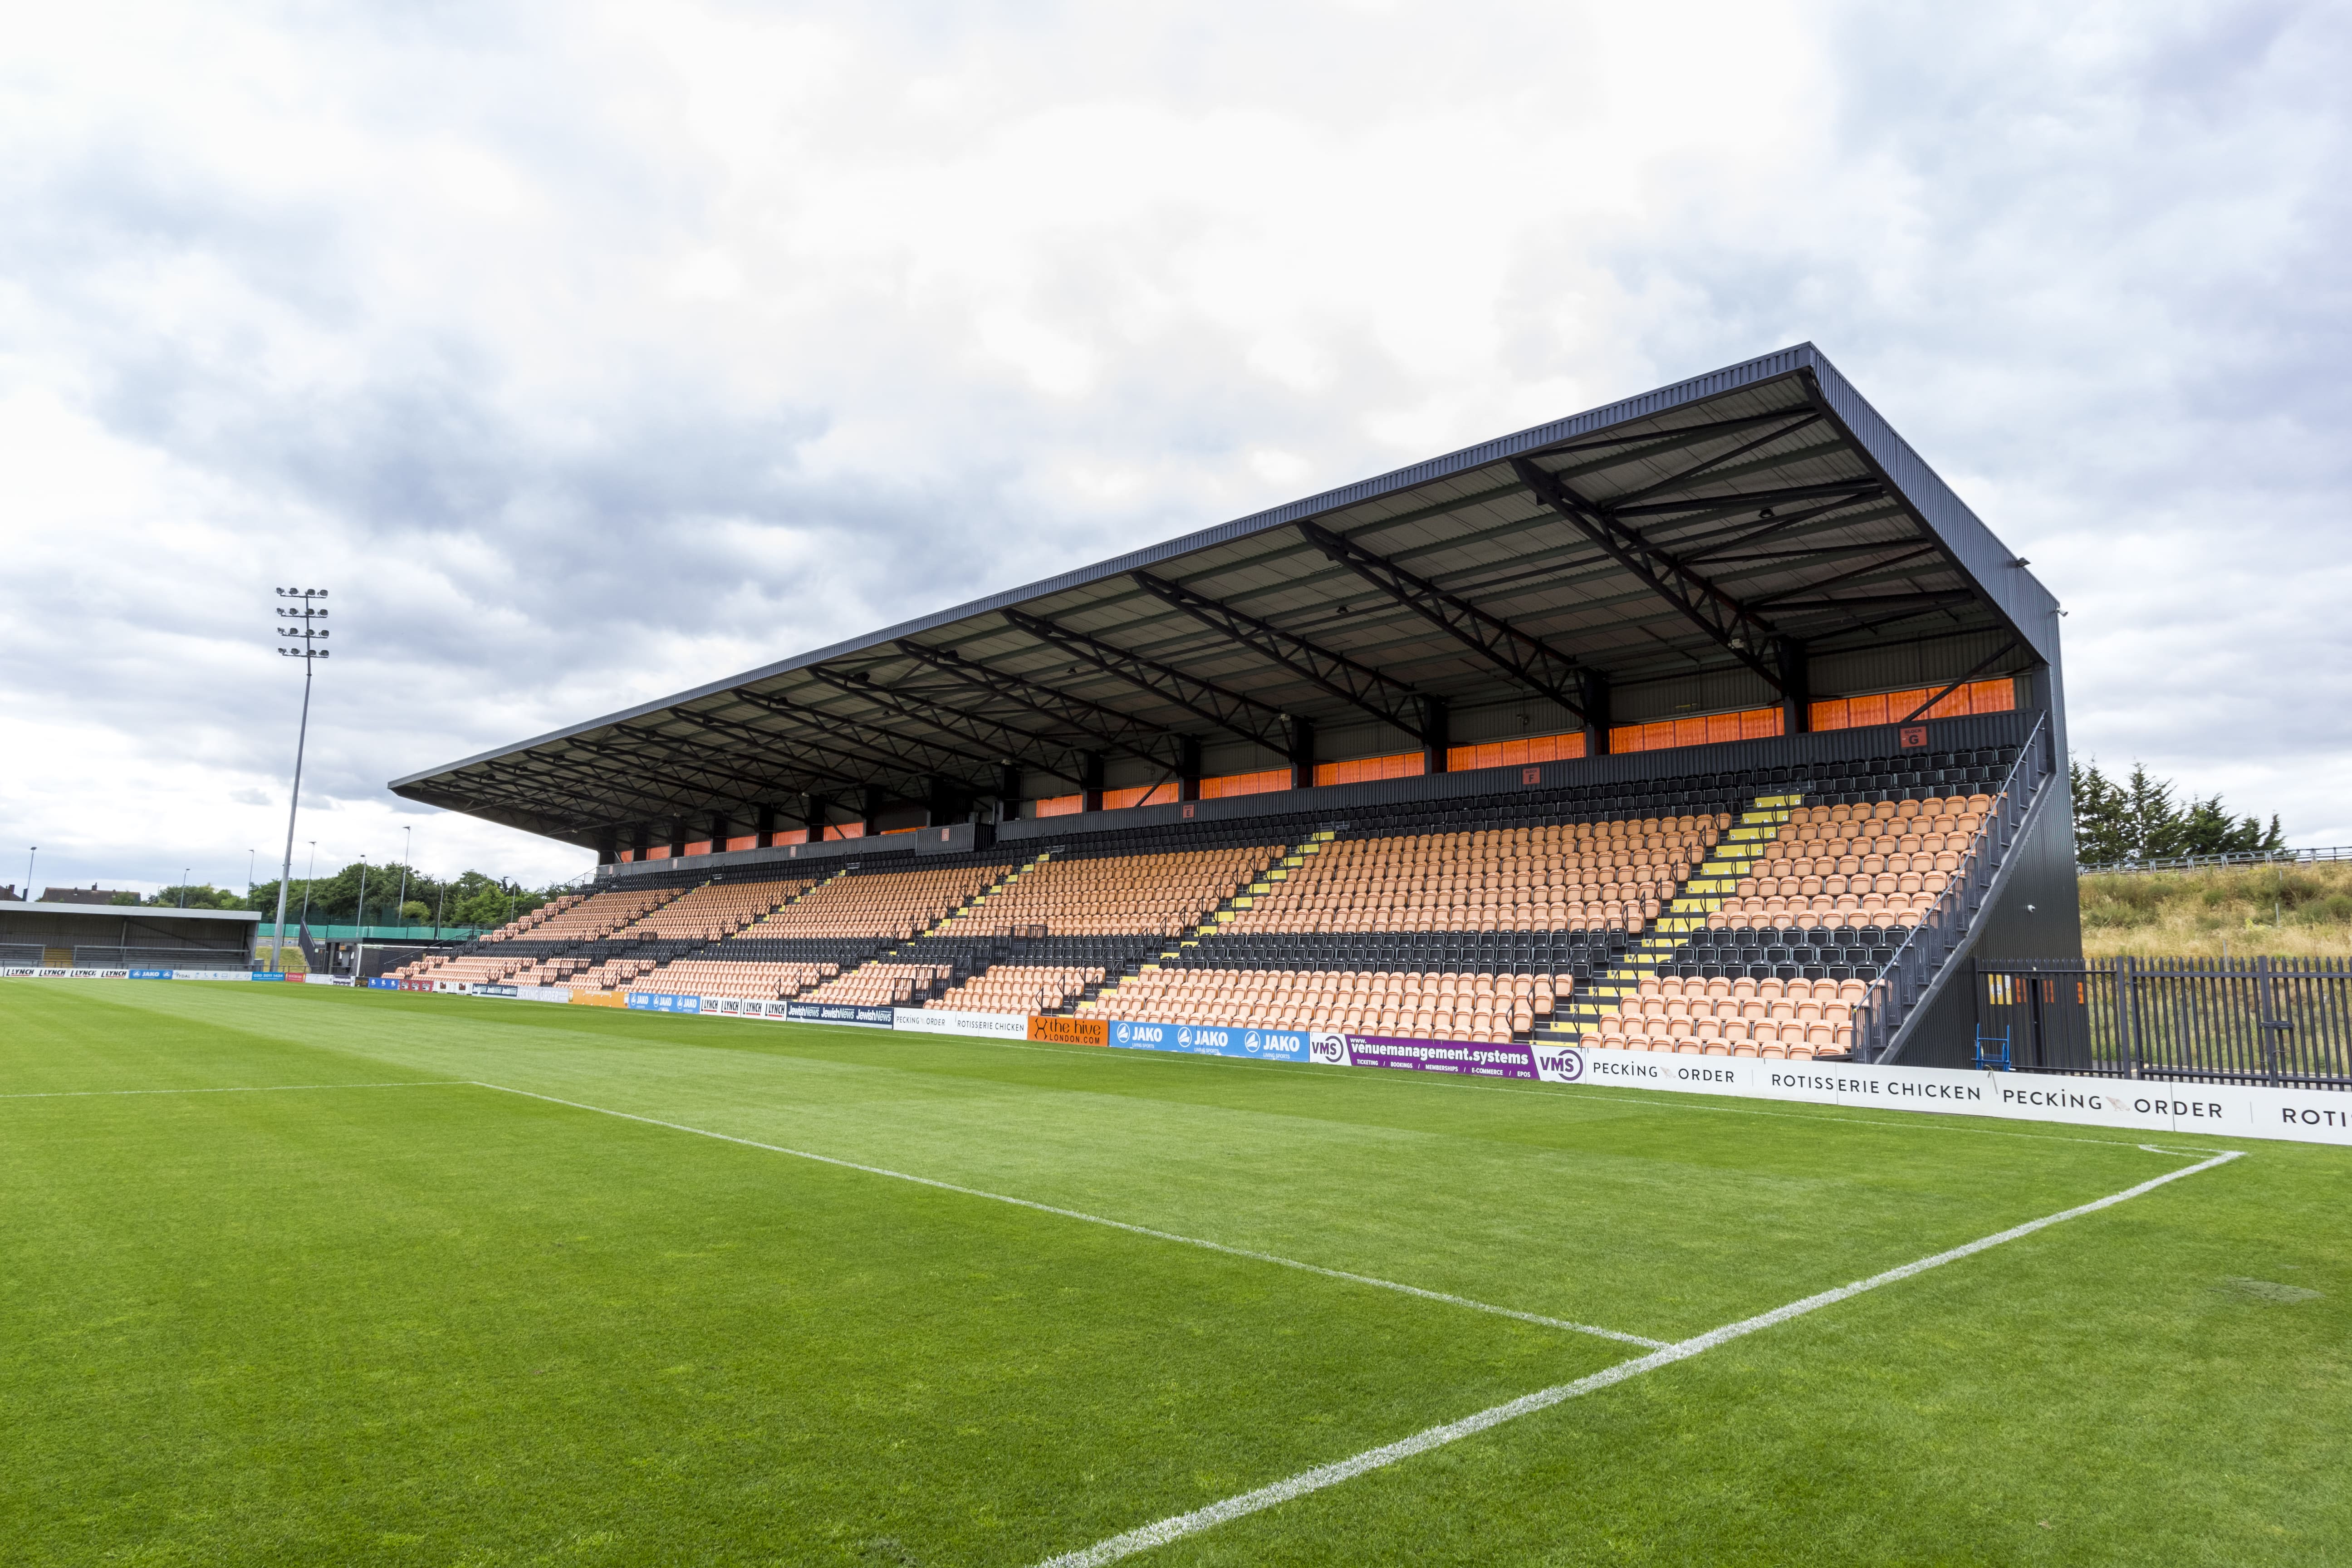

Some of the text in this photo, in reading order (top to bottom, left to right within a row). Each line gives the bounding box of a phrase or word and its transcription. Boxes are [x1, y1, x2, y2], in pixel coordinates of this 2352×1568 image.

[1909, 735, 1919, 745] G
[1529, 774, 1534, 783] F
[540, 990, 559, 1001] ORDER
[637, 995, 649, 1004] JAKO
[659, 996, 672, 1006] JAKO
[683, 998, 697, 1009] JAKO
[704, 1000, 718, 1009] LYNCH
[724, 1001, 739, 1011] LYNCH
[746, 1002, 762, 1013] LYNCH
[769, 1004, 785, 1014] LYNCH
[926, 1018, 945, 1026] ORDER
[957, 1020, 993, 1029] ROTISSERIE
[995, 1023, 1024, 1031] CHICKEN
[1050, 1019, 1101, 1035] the hive
[1049, 1034, 1100, 1044] LONDON.COM
[1132, 1027, 1162, 1042] JAKO
[1194, 1030, 1228, 1047] JAKO
[1263, 1035, 1300, 1052] JAKO
[1312, 1041, 1337, 1055] VMS
[1351, 1043, 1529, 1065] venuemanagement.systems
[1425, 1063, 1459, 1072] MEMBERSHIPS
[1471, 1067, 1503, 1076] E-COMMERCE
[1540, 1056, 1574, 1073] VMS
[1678, 1068, 1734, 1083] ORDER
[1772, 1074, 1879, 1094] ROTISSERIE
[1887, 1082, 1980, 1100] CHICKEN
[2134, 1098, 2222, 1119] ORDER
[2282, 1108, 2352, 1127] ROTI
